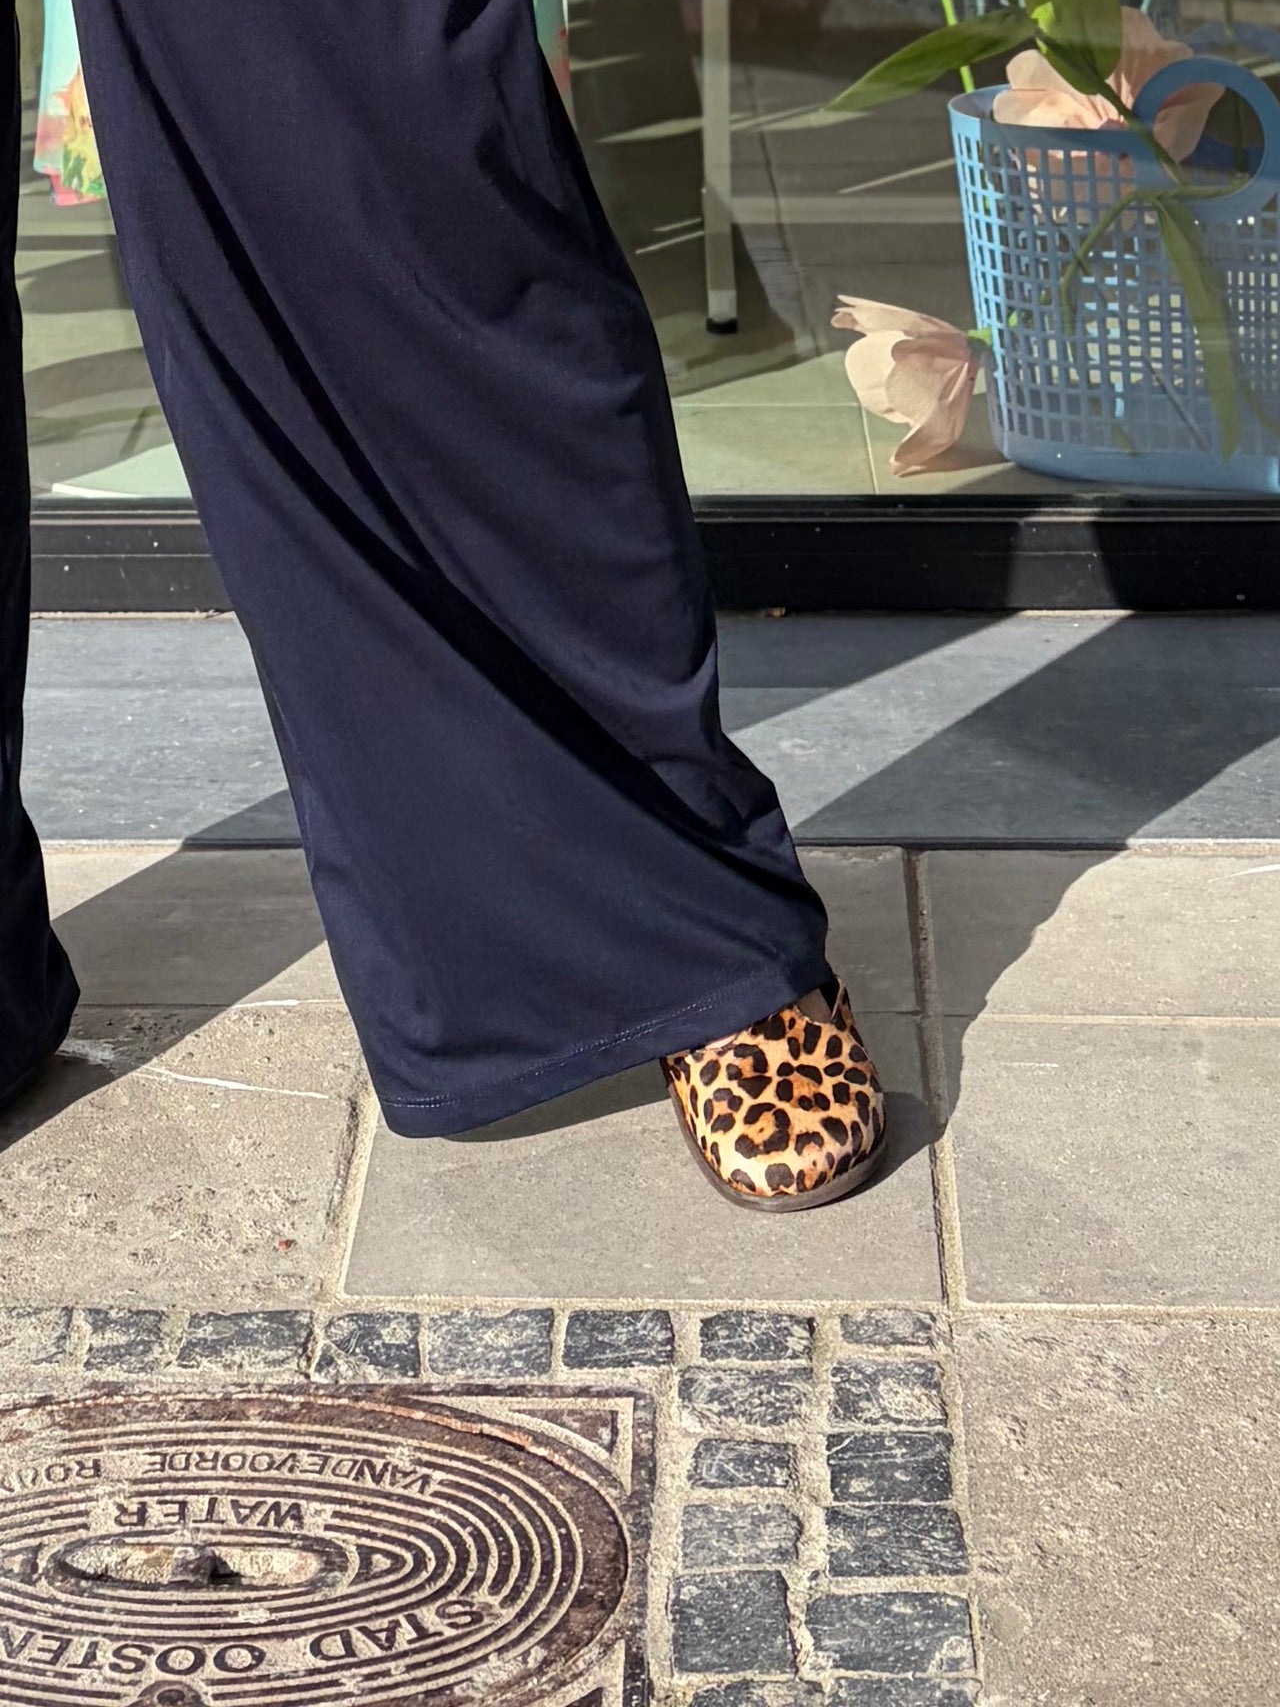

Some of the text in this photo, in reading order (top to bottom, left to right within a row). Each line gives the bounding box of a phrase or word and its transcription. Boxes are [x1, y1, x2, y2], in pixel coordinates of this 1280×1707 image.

[148, 1450, 436, 1495] VANDEVOORDE
[114, 1495, 305, 1528] WATER
[309, 1598, 486, 1662] STAD
